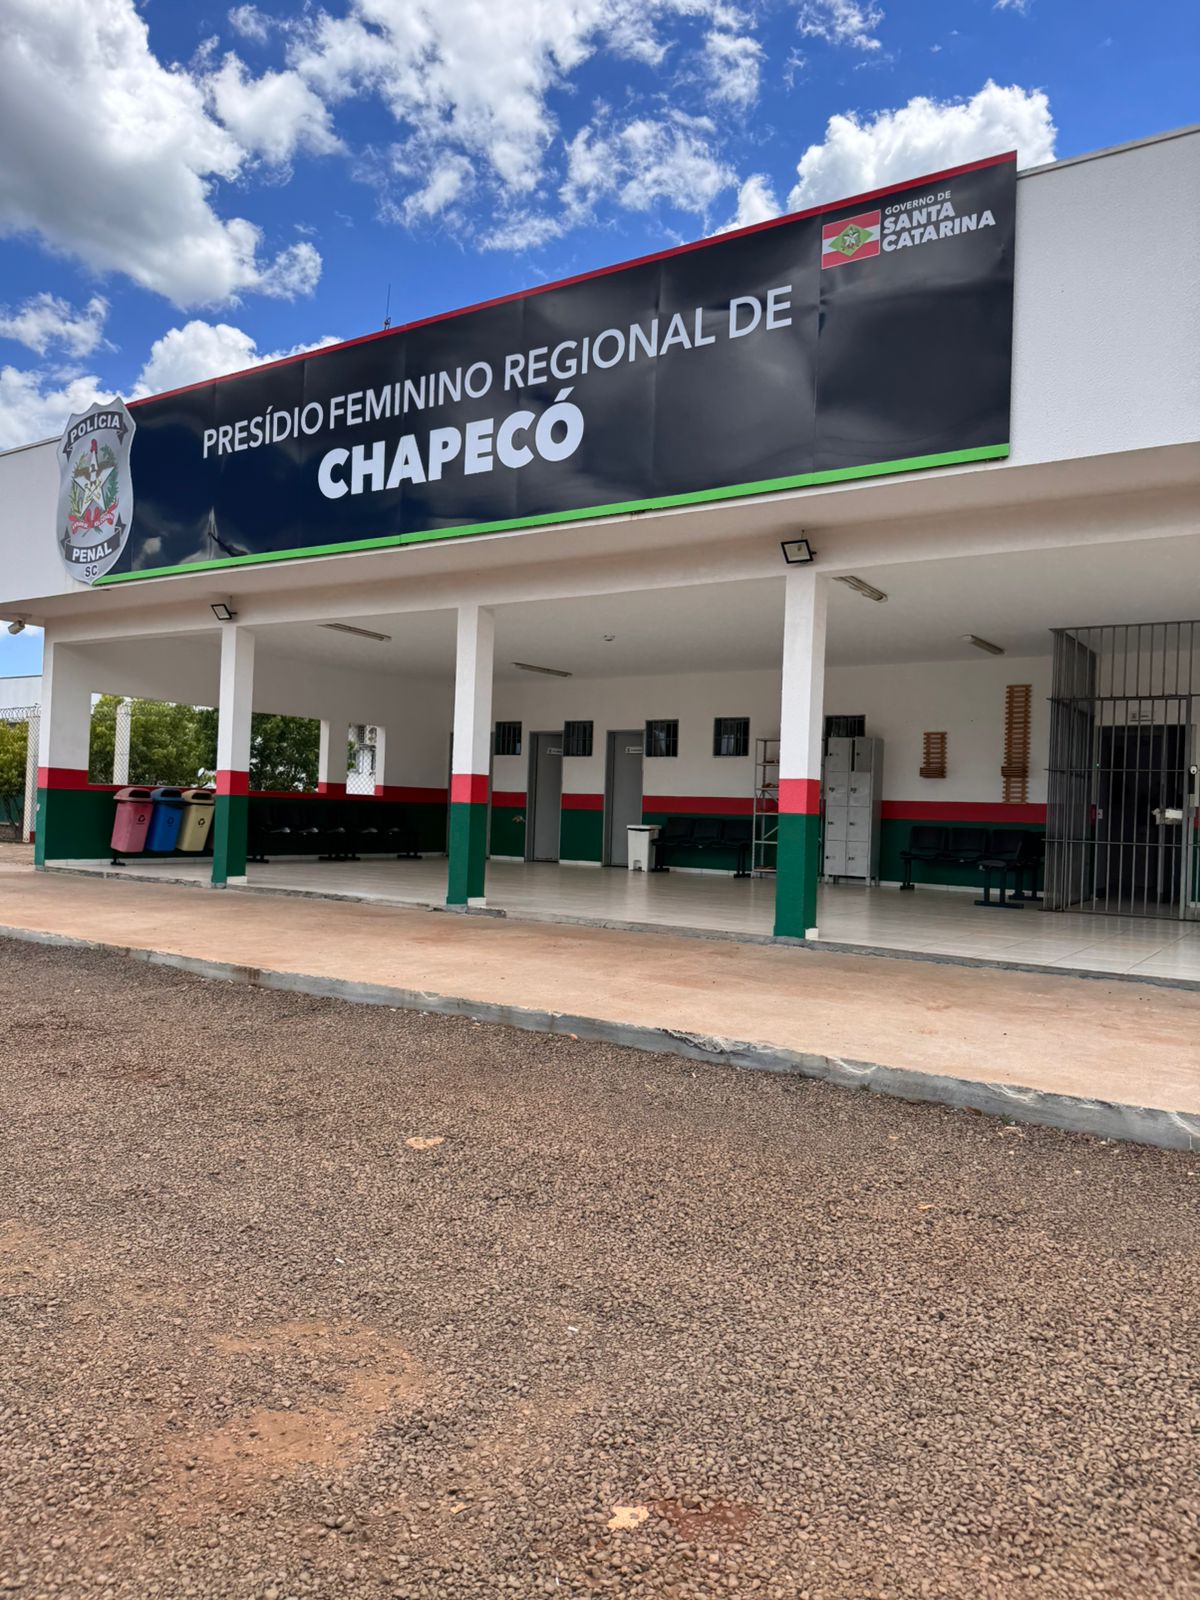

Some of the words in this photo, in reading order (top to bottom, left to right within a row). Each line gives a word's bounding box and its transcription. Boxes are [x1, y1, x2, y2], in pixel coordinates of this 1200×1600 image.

[883, 201, 956, 234] SANTA
[884, 195, 935, 215] GOVERNO
[937, 190, 952, 201] DE
[882, 210, 996, 252] CATARINA
[203, 402, 324, 459] PRESÍDIO
[329, 361, 493, 429] FEMININO
[504, 307, 717, 391] REGIONAL
[728, 285, 793, 339] DE
[70, 414, 121, 444] POLÍCIA
[317, 386, 585, 499] CHAPECÓ
[72, 542, 113, 563] PENAL
[85, 564, 98, 577] SC
